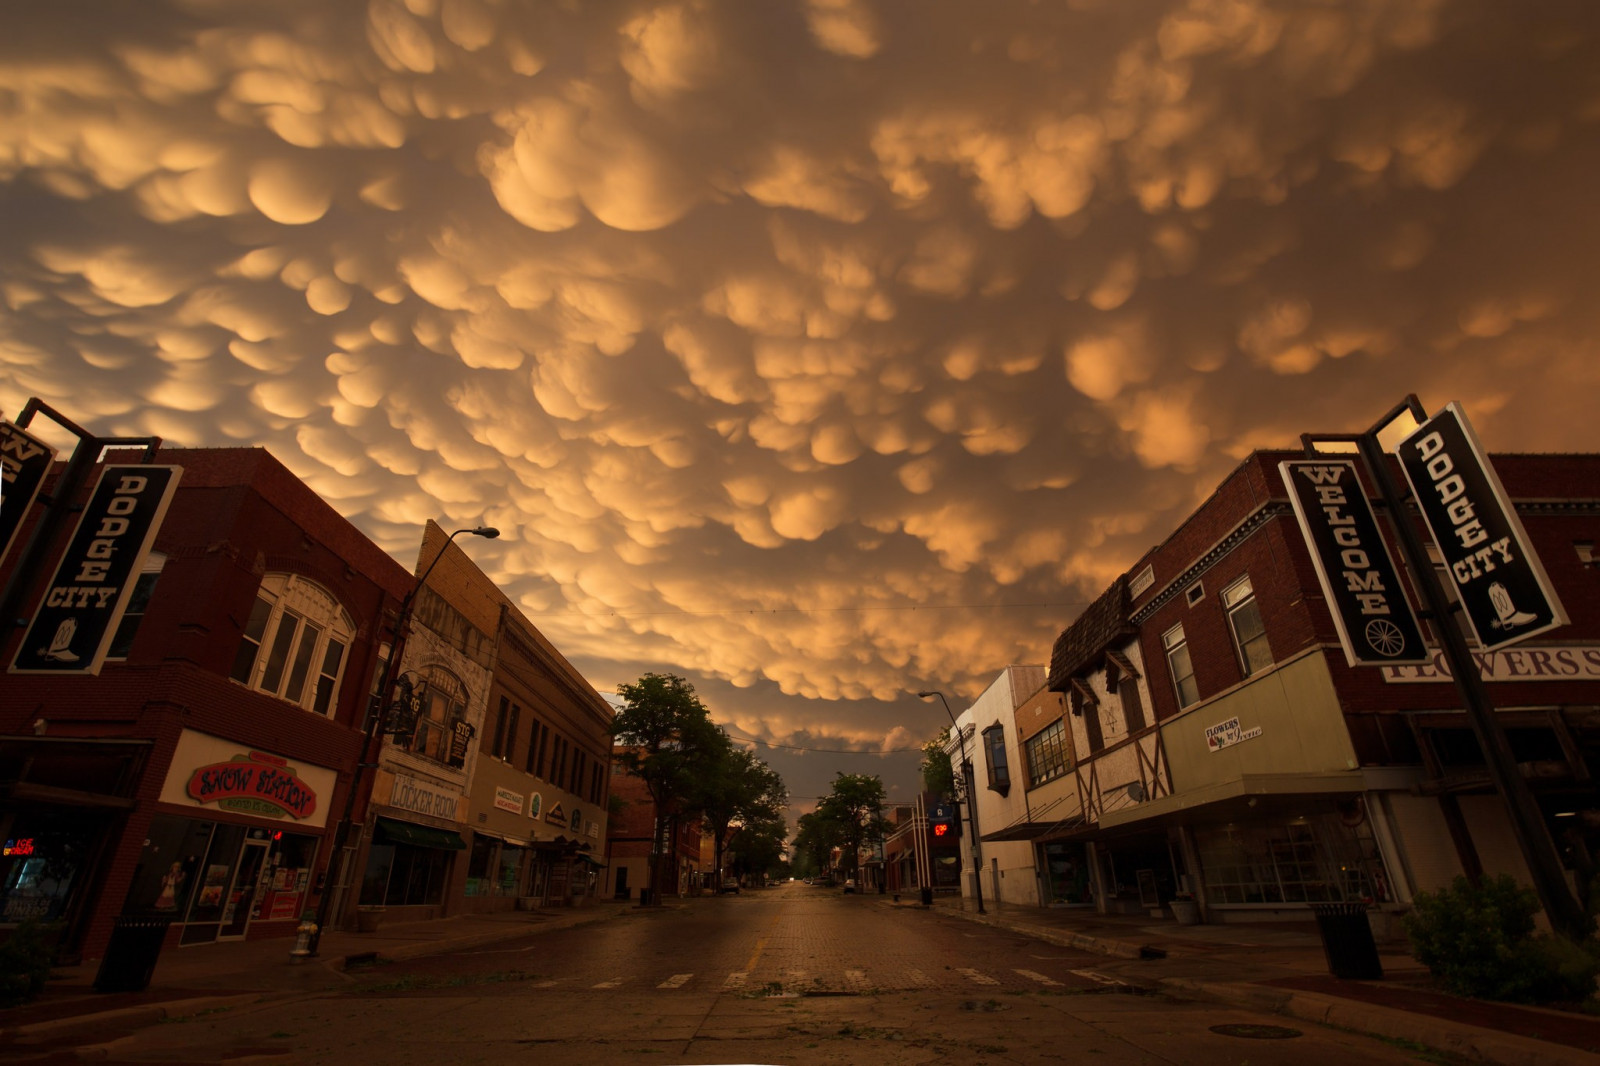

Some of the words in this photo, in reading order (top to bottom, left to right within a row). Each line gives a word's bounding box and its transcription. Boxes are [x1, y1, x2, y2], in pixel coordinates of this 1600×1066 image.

[1415, 431, 1489, 548] DODGE
[75, 475, 149, 582] DODGE
[1297, 466, 1391, 615] WELCOME
[1452, 536, 1514, 584] CITY
[46, 587, 117, 608] CITY
[455, 721, 471, 737] STG
[1205, 718, 1239, 738] FLOWERS
[200, 767, 253, 796] SNOW
[255, 767, 312, 814] STATION
[392, 783, 433, 817] LOCKER
[433, 793, 458, 821] ROOM
[16, 838, 34, 848] ICE
